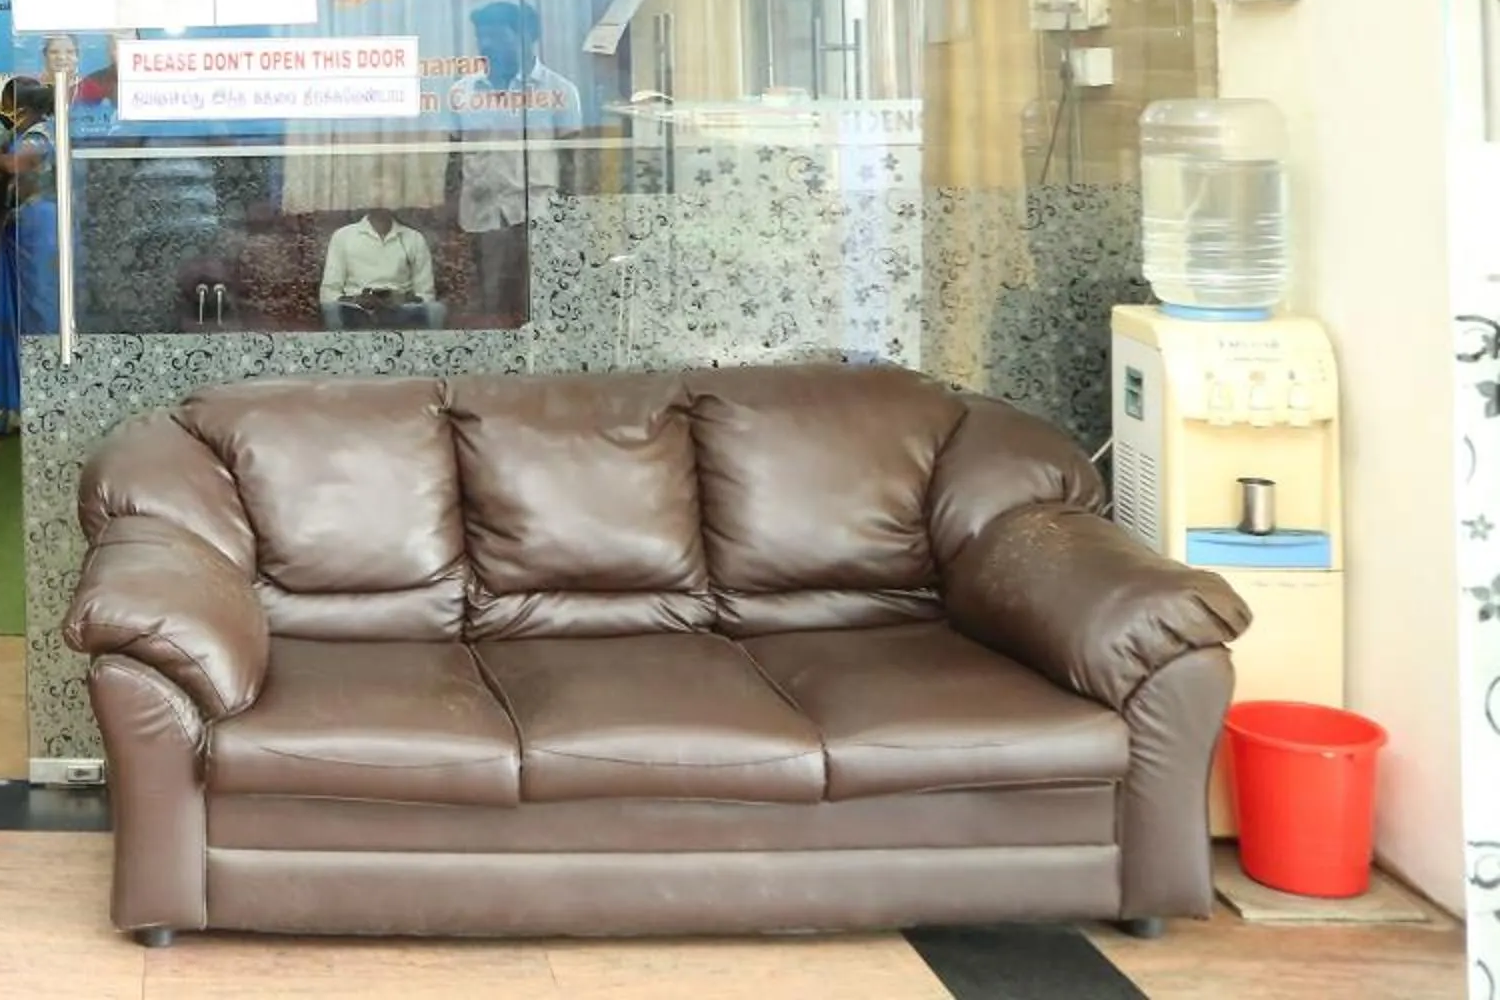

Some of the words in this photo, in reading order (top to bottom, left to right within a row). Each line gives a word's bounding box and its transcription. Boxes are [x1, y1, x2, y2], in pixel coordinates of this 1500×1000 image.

[132, 53, 197, 71] PLEASE
[203, 52, 254, 71] DON'T
[259, 51, 306, 70] OPEN
[312, 50, 352, 70] THIS
[357, 48, 406, 69] DOOR
[449, 85, 566, 116] Complex
